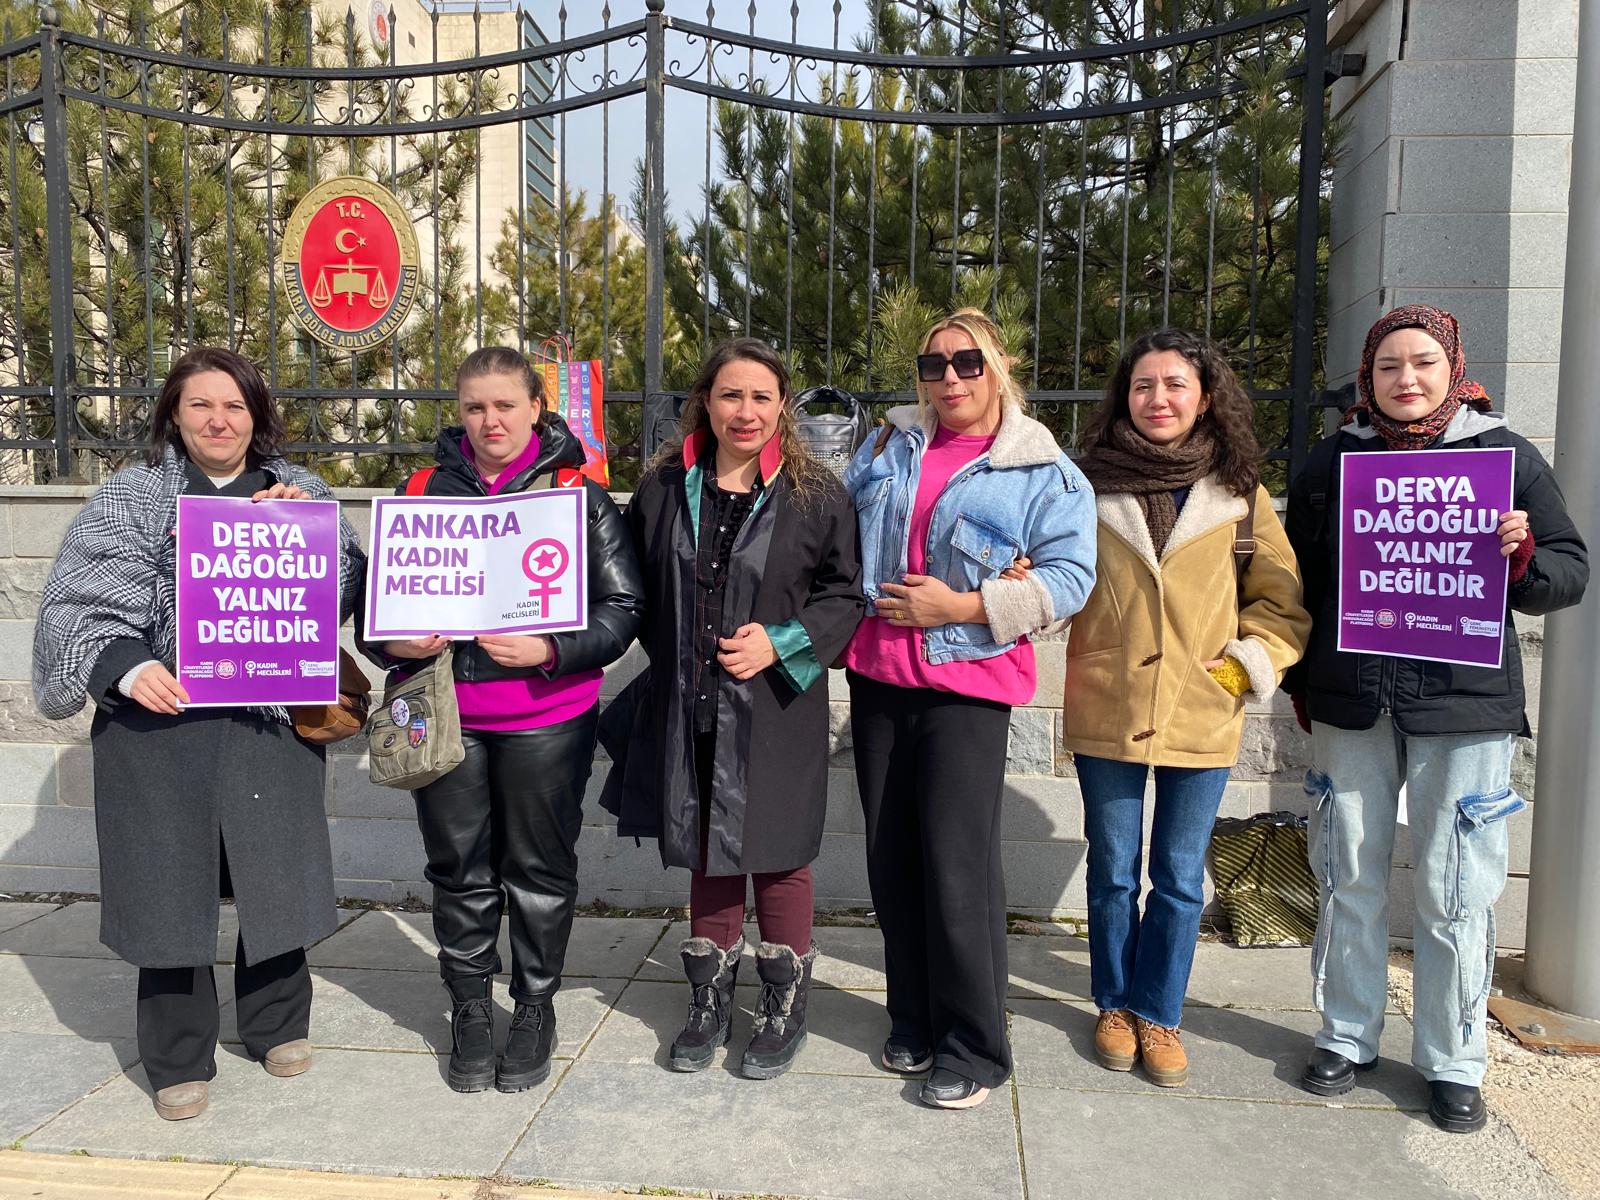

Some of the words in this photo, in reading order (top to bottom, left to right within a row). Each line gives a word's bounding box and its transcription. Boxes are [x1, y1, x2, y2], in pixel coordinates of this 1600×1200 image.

[335, 202, 365, 219] T.C.
[284, 264, 305, 314] ANKARA
[303, 313, 336, 343] BÖLGE
[337, 332, 379, 348] ADLİYE
[379, 266, 417, 336] MAHKEMESİ
[1375, 476, 1476, 504] DERYA
[386, 511, 522, 539] ANKARA
[1353, 504, 1499, 534] DAĞOĞLU
[212, 521, 307, 549] DERYA
[190, 549, 328, 579] DAĞOĞLU
[386, 547, 469, 568] KADIN
[1375, 541, 1473, 565] YALNIZ
[385, 570, 485, 596] MECLİSİ
[1359, 568, 1485, 599] DEĞİLDİR
[212, 587, 307, 611] YALNIZ
[516, 600, 540, 609] KADIN
[501, 608, 540, 620] MECLİSLERİ
[1416, 622, 1452, 631] MECLİSLERİ
[197, 616, 320, 644] DEĞİLDİR
[256, 668, 292, 676] MECLİSLERİ
